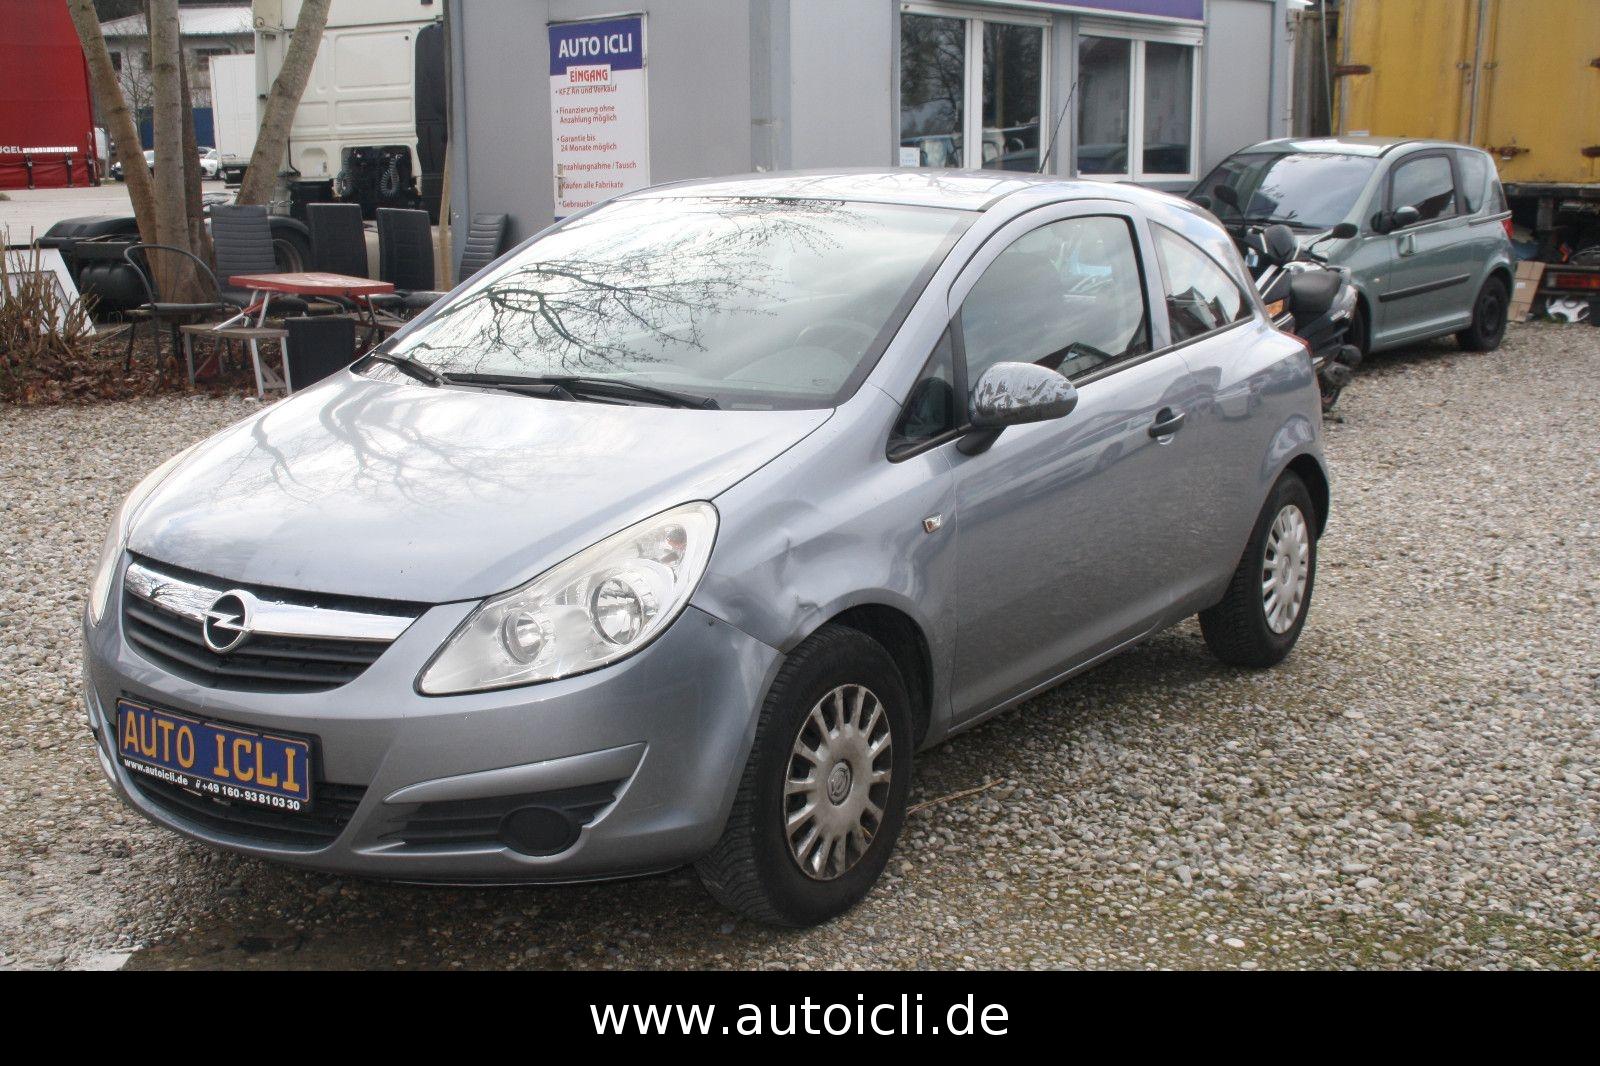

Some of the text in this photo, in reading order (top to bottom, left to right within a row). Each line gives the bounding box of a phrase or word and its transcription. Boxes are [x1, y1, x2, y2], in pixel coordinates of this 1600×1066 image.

[558, 33, 633, 58] AUTO ICLI
[570, 69, 608, 82] EINGANG
[594, 84, 617, 92] Verkauf
[559, 106, 598, 114] Finanzierung
[560, 114, 617, 124] Anzahlung möglich
[560, 134, 596, 143] Garantie bis
[569, 144, 591, 152] Monate
[593, 143, 617, 152] möglich
[561, 162, 611, 171] nzahlungnahme
[616, 161, 637, 169] Tausch
[562, 182, 582, 190] Kaufen
[596, 181, 623, 189] Fabrikate
[125, 711, 300, 792] AUTO ICLI
[124, 759, 189, 786] www.autoicli.de
[202, 783, 220, 794] +49
